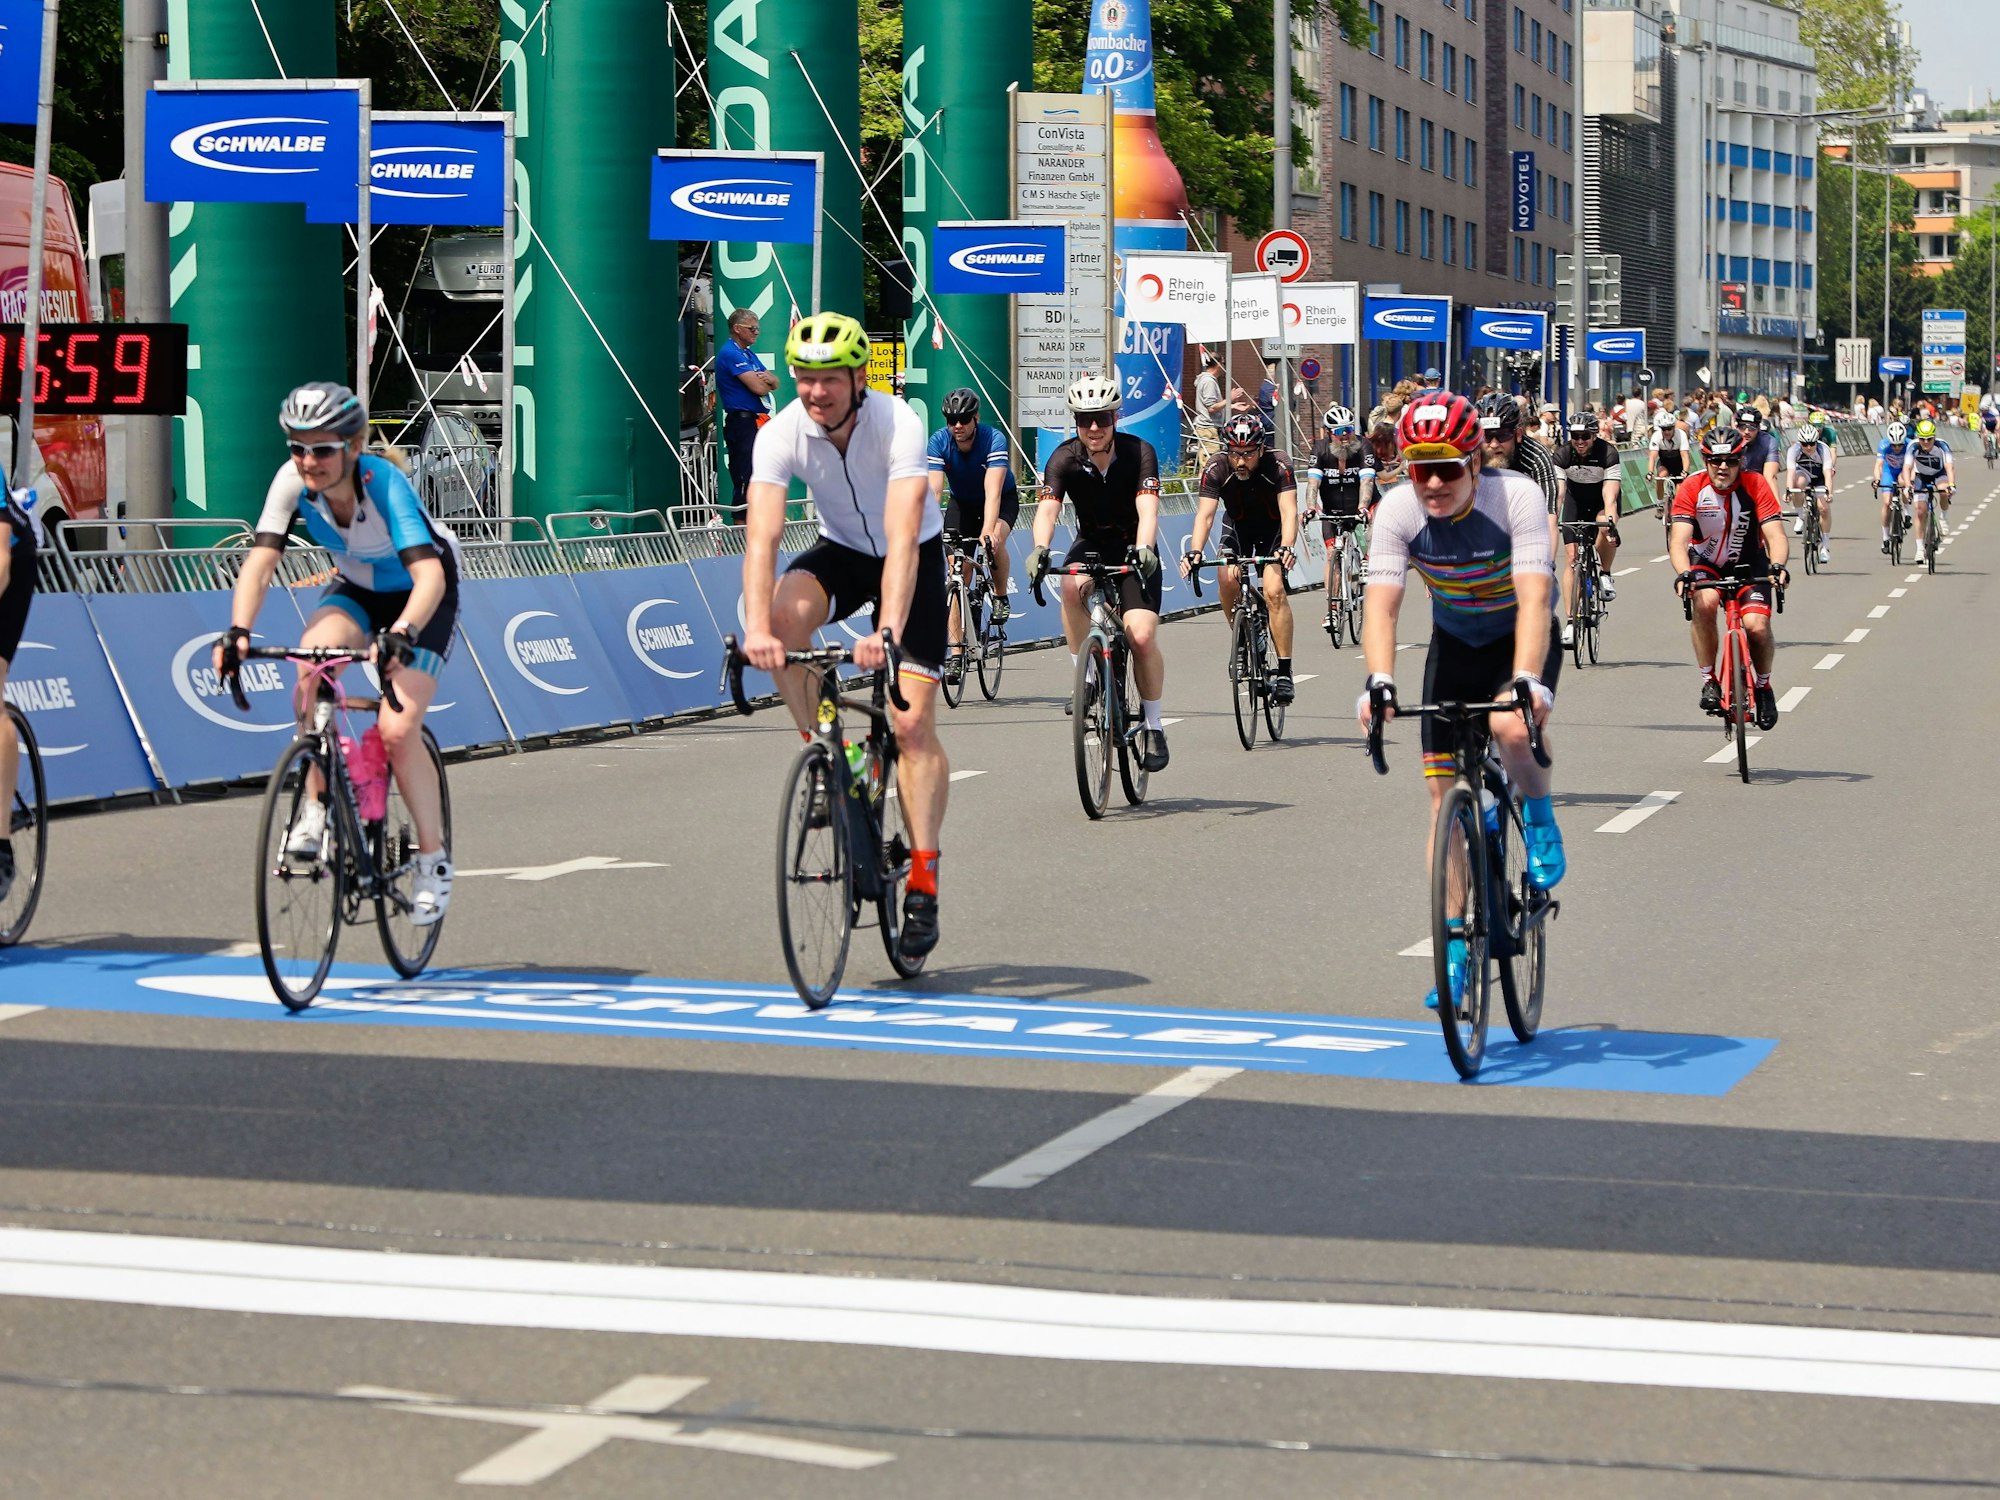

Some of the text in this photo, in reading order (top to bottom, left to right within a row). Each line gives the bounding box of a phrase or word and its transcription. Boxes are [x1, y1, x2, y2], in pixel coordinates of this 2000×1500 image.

[1038, 127, 1085, 139] ConVista
[199, 136, 326, 152] SCHWALBE
[1038, 143, 1073, 152] Consulting
[1038, 158, 1085, 168] NARANDER
[371, 163, 475, 179] CHWALBE
[1028, 171, 1095, 181] Finanzen GmbH
[1048, 190, 1077, 199] Hasche
[1080, 191, 1101, 201] Sigle
[1518, 153, 1529, 228] NOVOTEL
[691, 192, 790, 206] SCHWALBE
[966, 254, 1045, 264] SCHWALBE
[1070, 253, 1101, 262] artner
[1169, 278, 1204, 289] Rhein
[1168, 290, 1216, 303] Energie
[0, 289, 28, 323] RAC
[40, 290, 79, 323] RESULT
[1232, 298, 1257, 309] hein
[1498, 301, 1556, 312] NOVO
[1230, 308, 1270, 320] nergie
[1306, 306, 1336, 315] Rhein
[1306, 316, 1347, 326] Energie
[1384, 315, 1436, 323] SCHWALBE
[1490, 326, 1533, 334] SCHWALBE
[0, 334, 150, 403] 5:59
[866, 373, 890, 382] sgas
[1027, 371, 1073, 380] NARANDR
[1038, 385, 1065, 394] Immo
[473, 411, 500, 419] DA
[1703, 537, 1719, 560] EOBIKE
[638, 624, 694, 651] SCHWALBE
[516, 637, 577, 665] SCHWALBE
[190, 662, 285, 697] SCALBE
[3, 677, 76, 713] HWALBE
